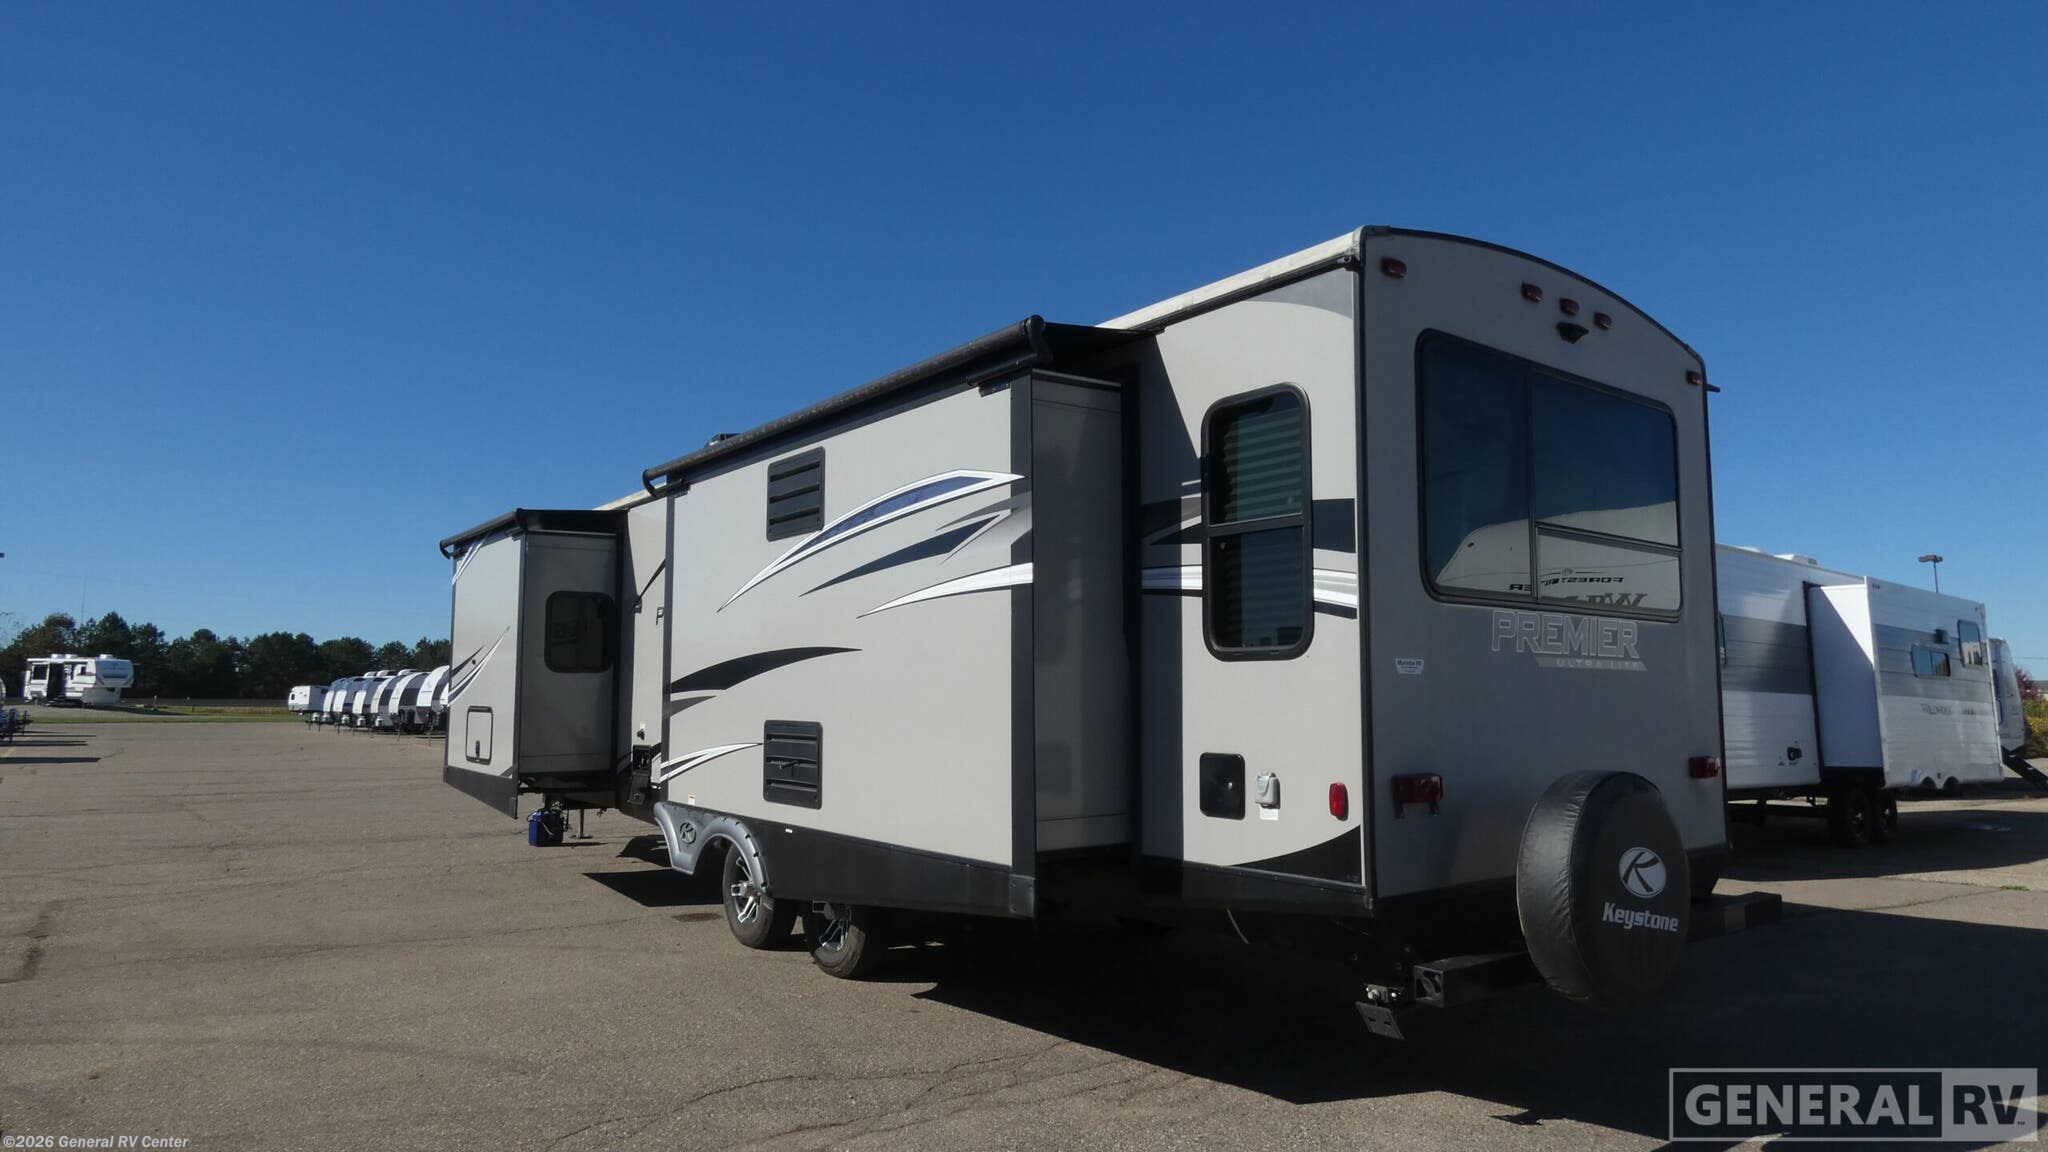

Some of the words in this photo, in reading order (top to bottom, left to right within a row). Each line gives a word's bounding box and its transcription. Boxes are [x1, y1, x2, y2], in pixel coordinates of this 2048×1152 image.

[1491, 609, 1640, 659] PREMIER
[1556, 657, 1602, 669] ULTRA
[1609, 660, 1640, 671] LITE
[1602, 902, 1679, 931] Keystone
